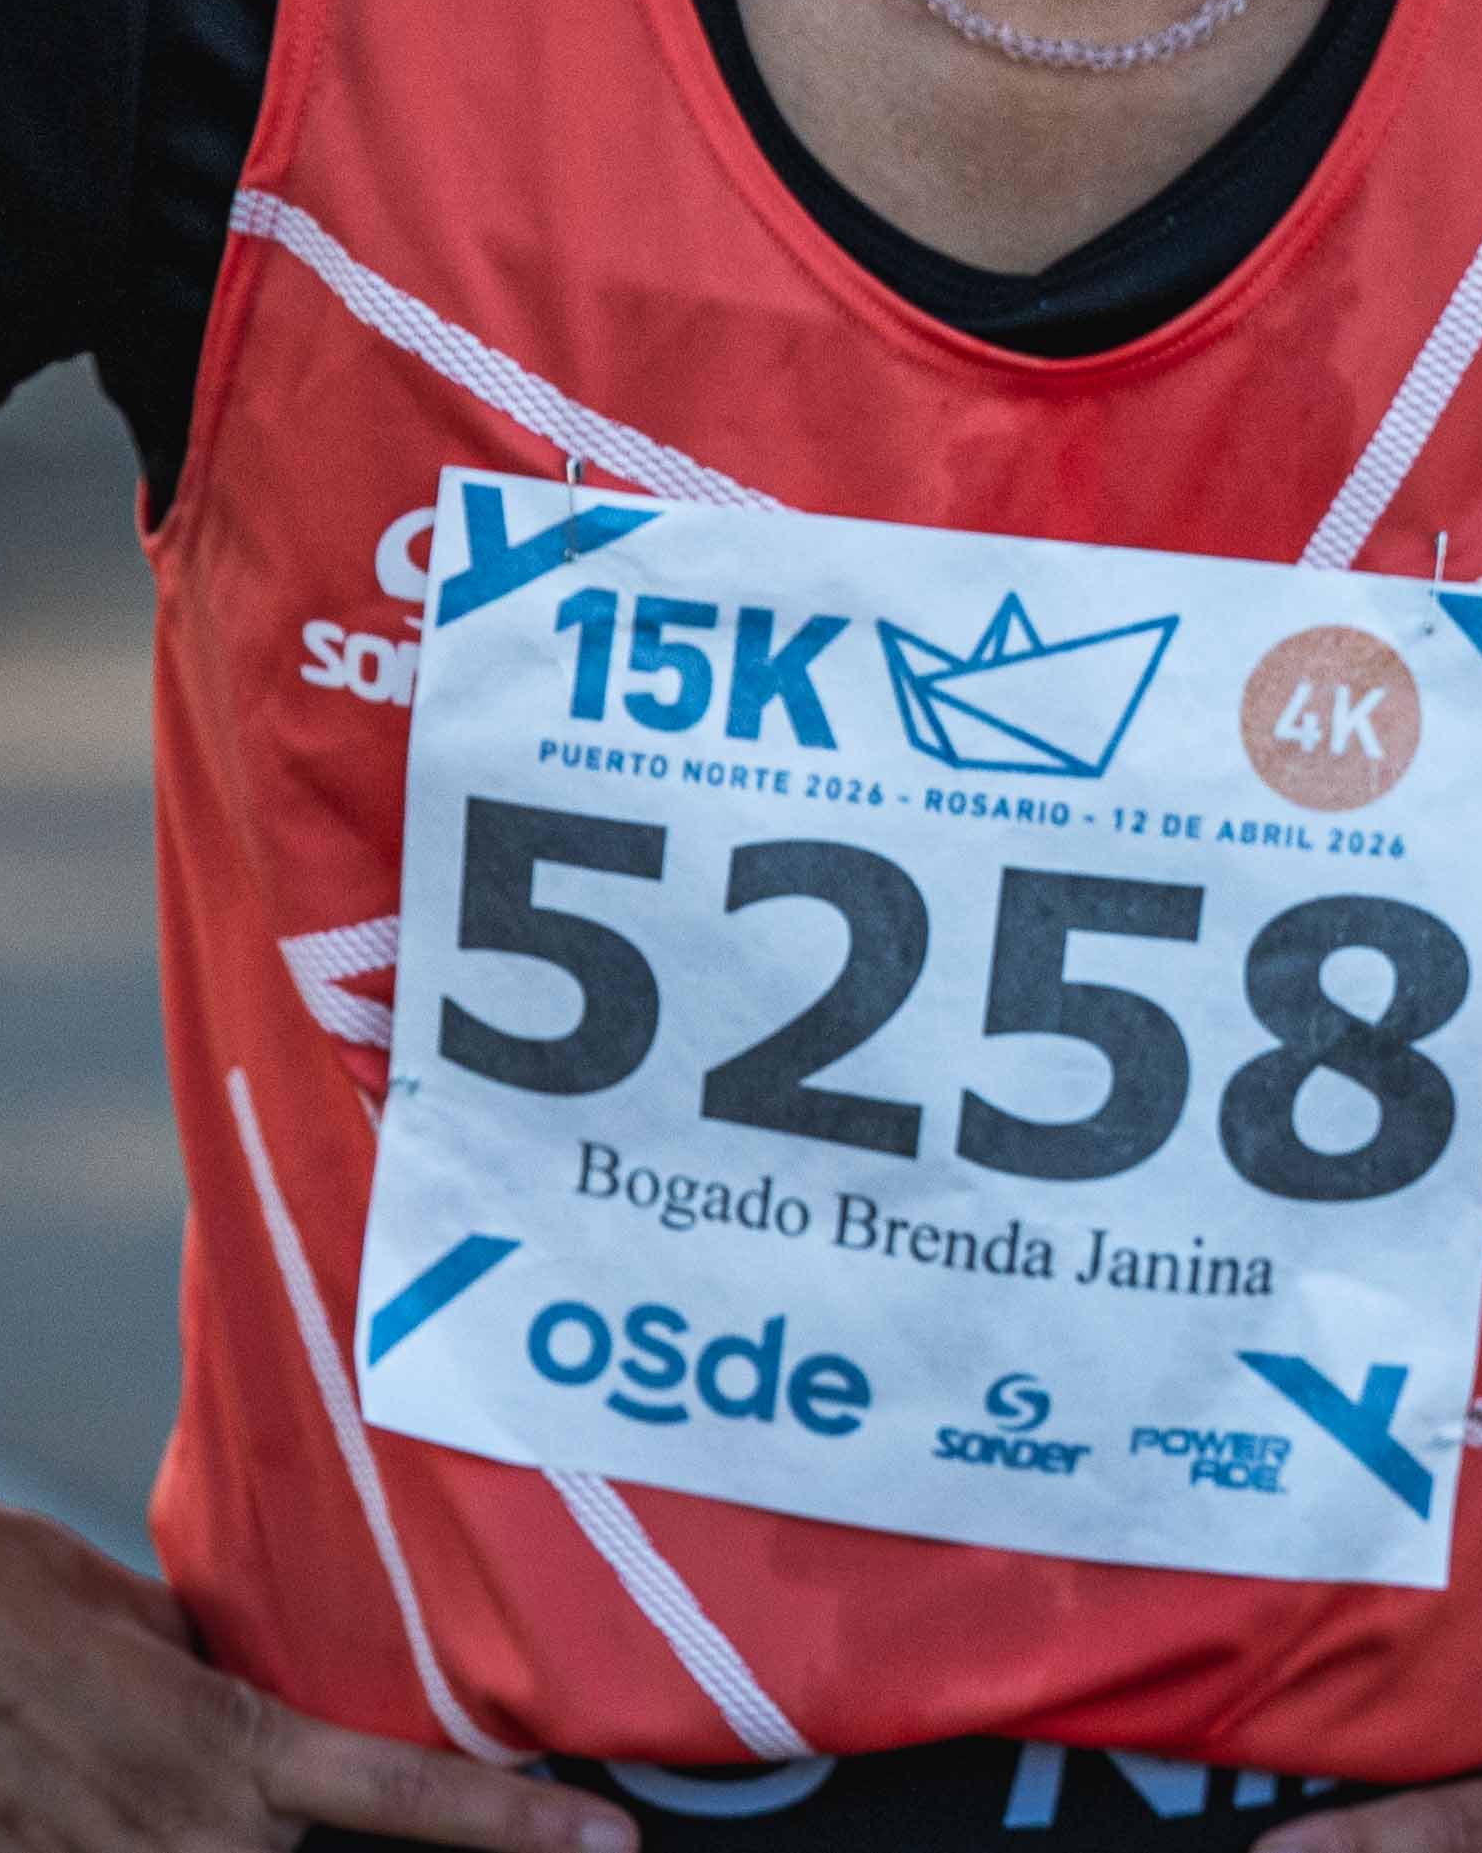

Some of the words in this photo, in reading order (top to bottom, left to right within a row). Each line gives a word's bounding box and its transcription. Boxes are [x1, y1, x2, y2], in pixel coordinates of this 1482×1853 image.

[555, 585, 852, 751] 15K
[1274, 680, 1387, 759] 4K
[538, 739, 668, 779] PUERTO
[683, 759, 791, 795] NORTE
[805, 774, 884, 807] 2026
[924, 788, 1071, 827] ROSARIO
[1114, 808, 1148, 835] 12
[1161, 813, 1202, 839] DE
[1216, 820, 1314, 851] ABRIL
[1328, 827, 1406, 859] 2026
[437, 795, 1470, 1205] 5258
[577, 1140, 813, 1236] Bogado
[835, 1191, 1054, 1279] Brenda
[1075, 1229, 1273, 1297] Janina
[527, 1300, 873, 1437] osde
[1130, 1427, 1292, 1466] POWER
